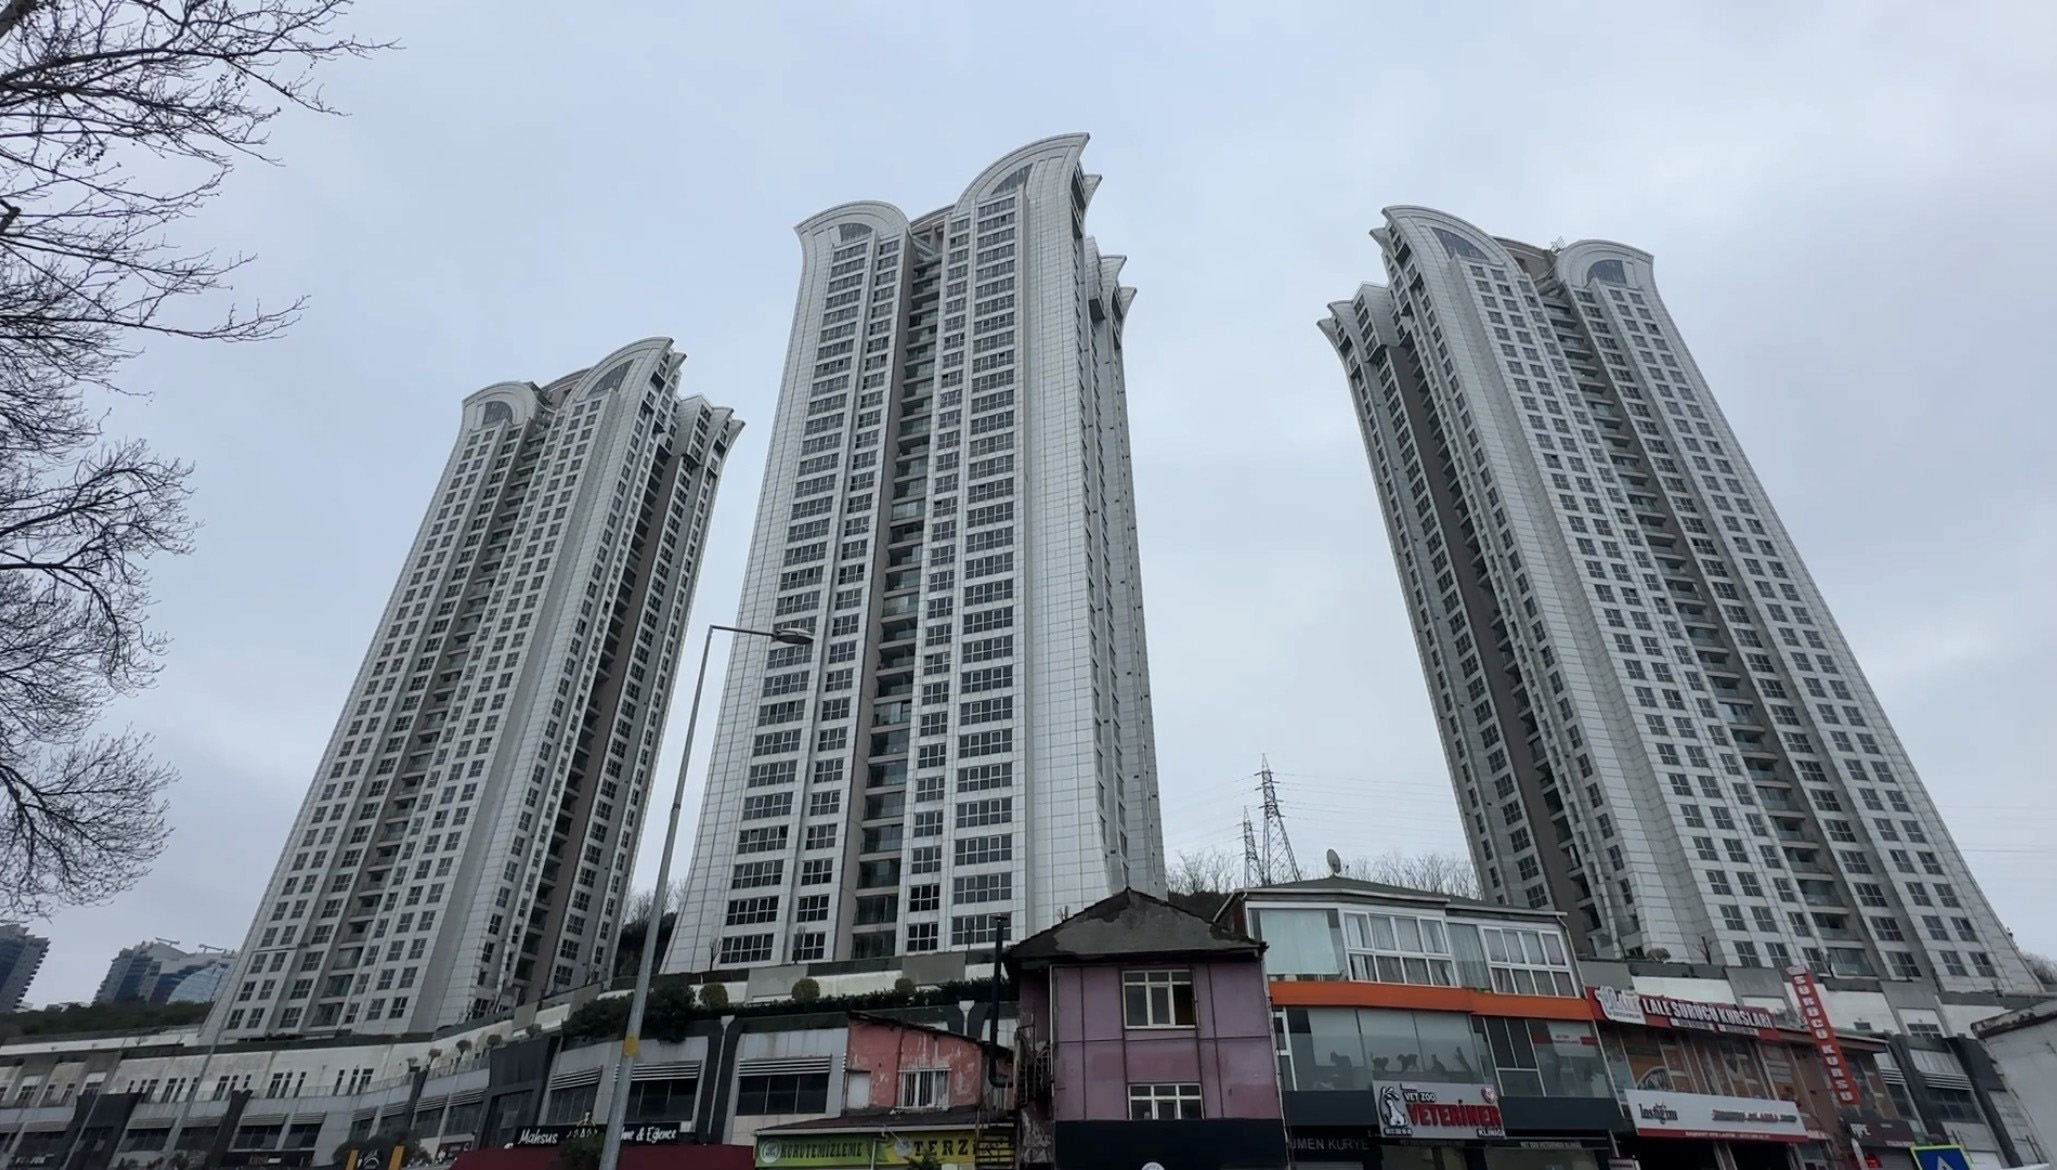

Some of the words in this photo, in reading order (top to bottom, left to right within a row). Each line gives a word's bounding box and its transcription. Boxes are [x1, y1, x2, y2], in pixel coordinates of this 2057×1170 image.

[1642, 998, 1671, 1016] LALE
[1821, 1044, 1854, 1102] KURSU
[1403, 1092, 1418, 1102] VET
[1420, 1093, 1436, 1102] ZOO
[518, 1127, 559, 1145] Mahsus
[636, 1127, 645, 1141] &
[1328, 1138, 1370, 1150] KURYE
